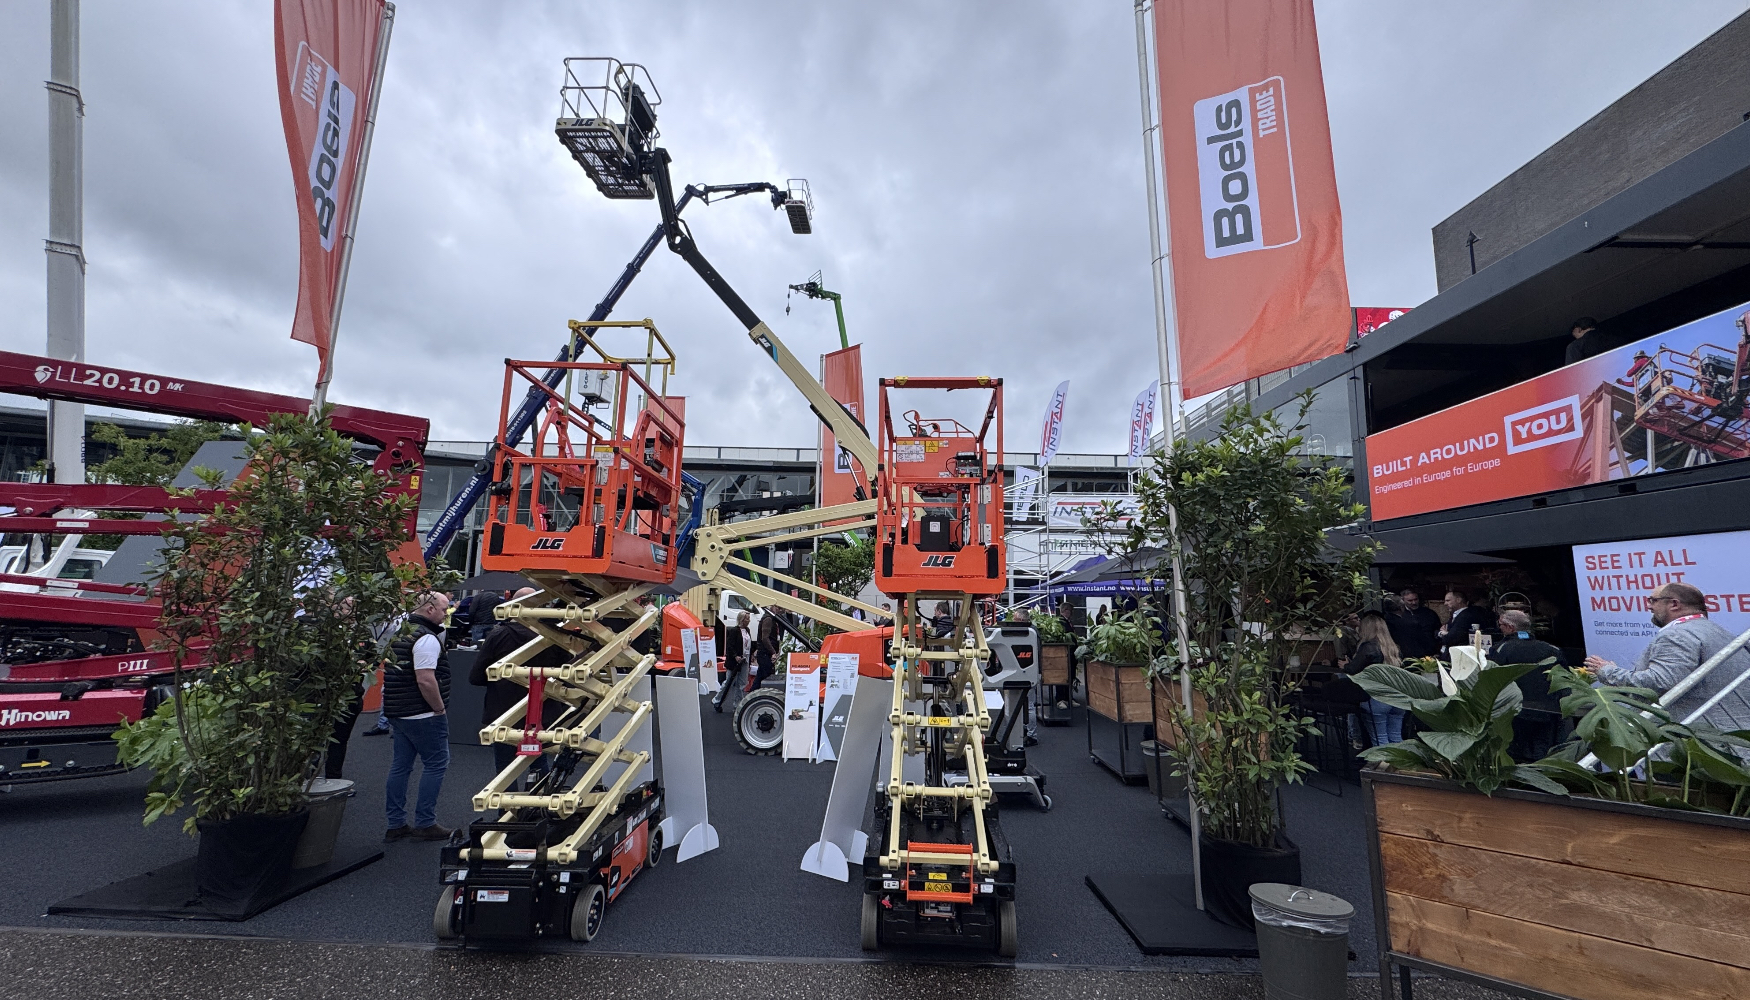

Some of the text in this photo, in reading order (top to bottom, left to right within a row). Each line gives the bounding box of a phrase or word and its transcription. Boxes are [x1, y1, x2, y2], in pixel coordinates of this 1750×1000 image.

[570, 118, 596, 127] JLG
[1255, 86, 1278, 138] TRADE
[1206, 98, 1254, 249] Boels
[166, 381, 185, 392] MK
[1048, 390, 1065, 452] INSTANT
[1132, 400, 1145, 458] INSTANT
[1373, 411, 1567, 478] BUILT AROUND YOU
[1375, 458, 1501, 494] Engineered in Europe for Europe
[530, 537, 566, 550] JLG
[921, 555, 956, 568] JLG
[1584, 548, 1697, 571] SEE IT ALL
[1586, 572, 1685, 591] WITHOUT
[1590, 596, 1652, 612] MOVI
[1595, 629, 1629, 637] connected
